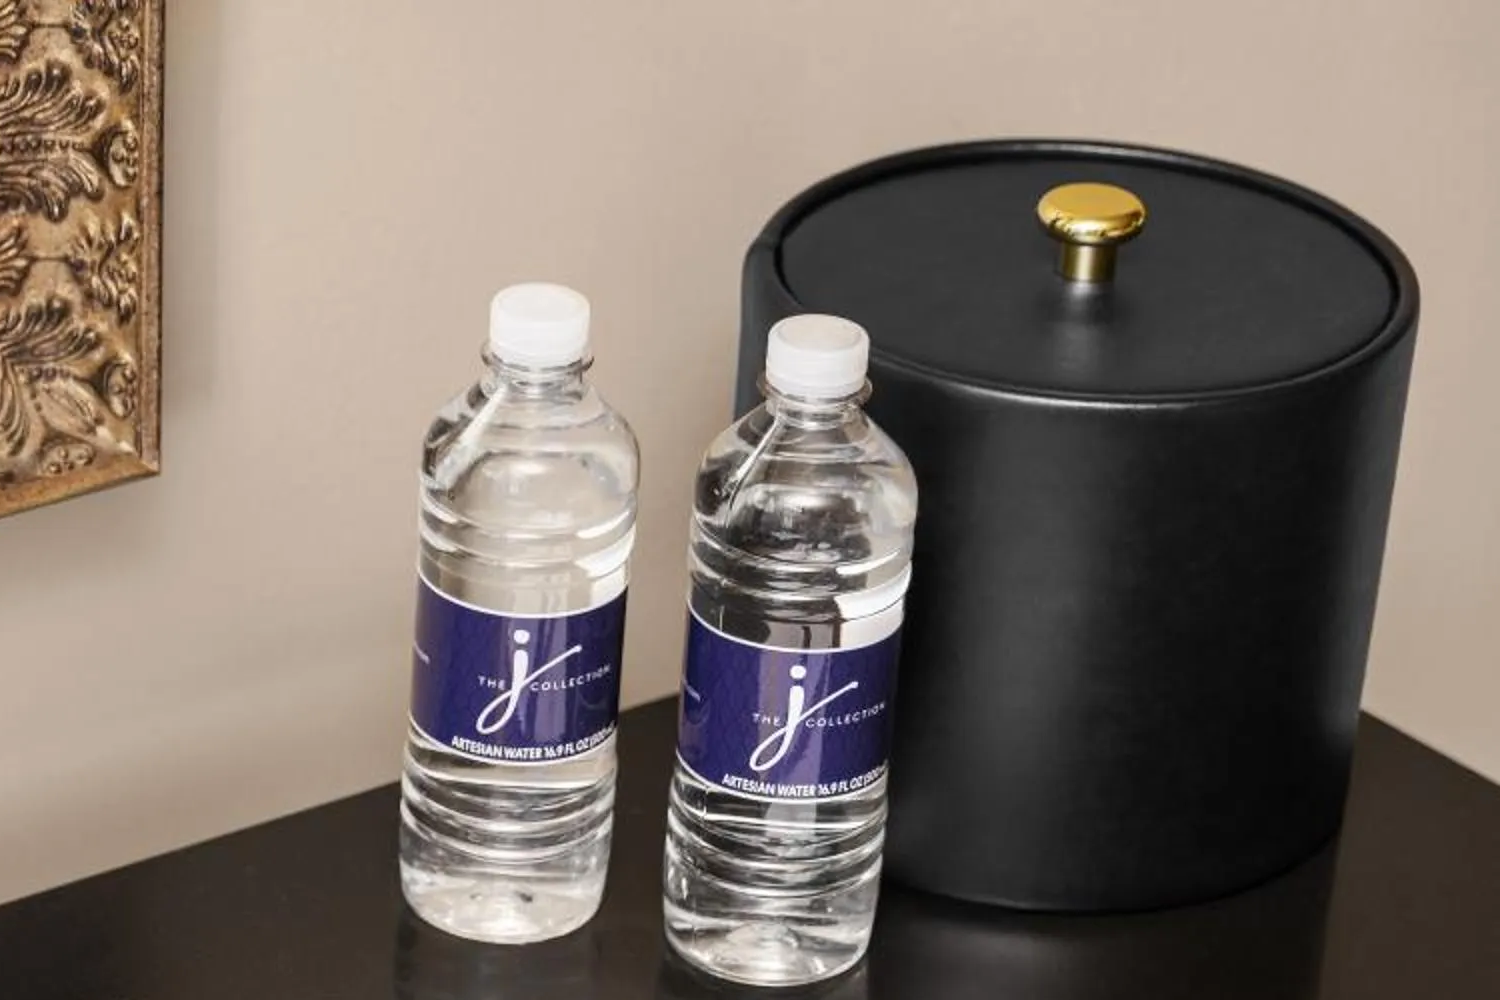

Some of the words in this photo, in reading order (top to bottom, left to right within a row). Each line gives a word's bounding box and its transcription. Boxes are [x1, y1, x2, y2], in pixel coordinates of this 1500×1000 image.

[477, 675, 505, 691] THE
[529, 663, 612, 692] COLLECTION
[752, 712, 781, 727] THE
[805, 701, 886, 728] COLLECTION
[451, 735, 502, 758] ARTESIAN
[504, 746, 543, 760] WATER
[721, 773, 775, 796] ARTESIAN
[777, 782, 816, 797] WATER
